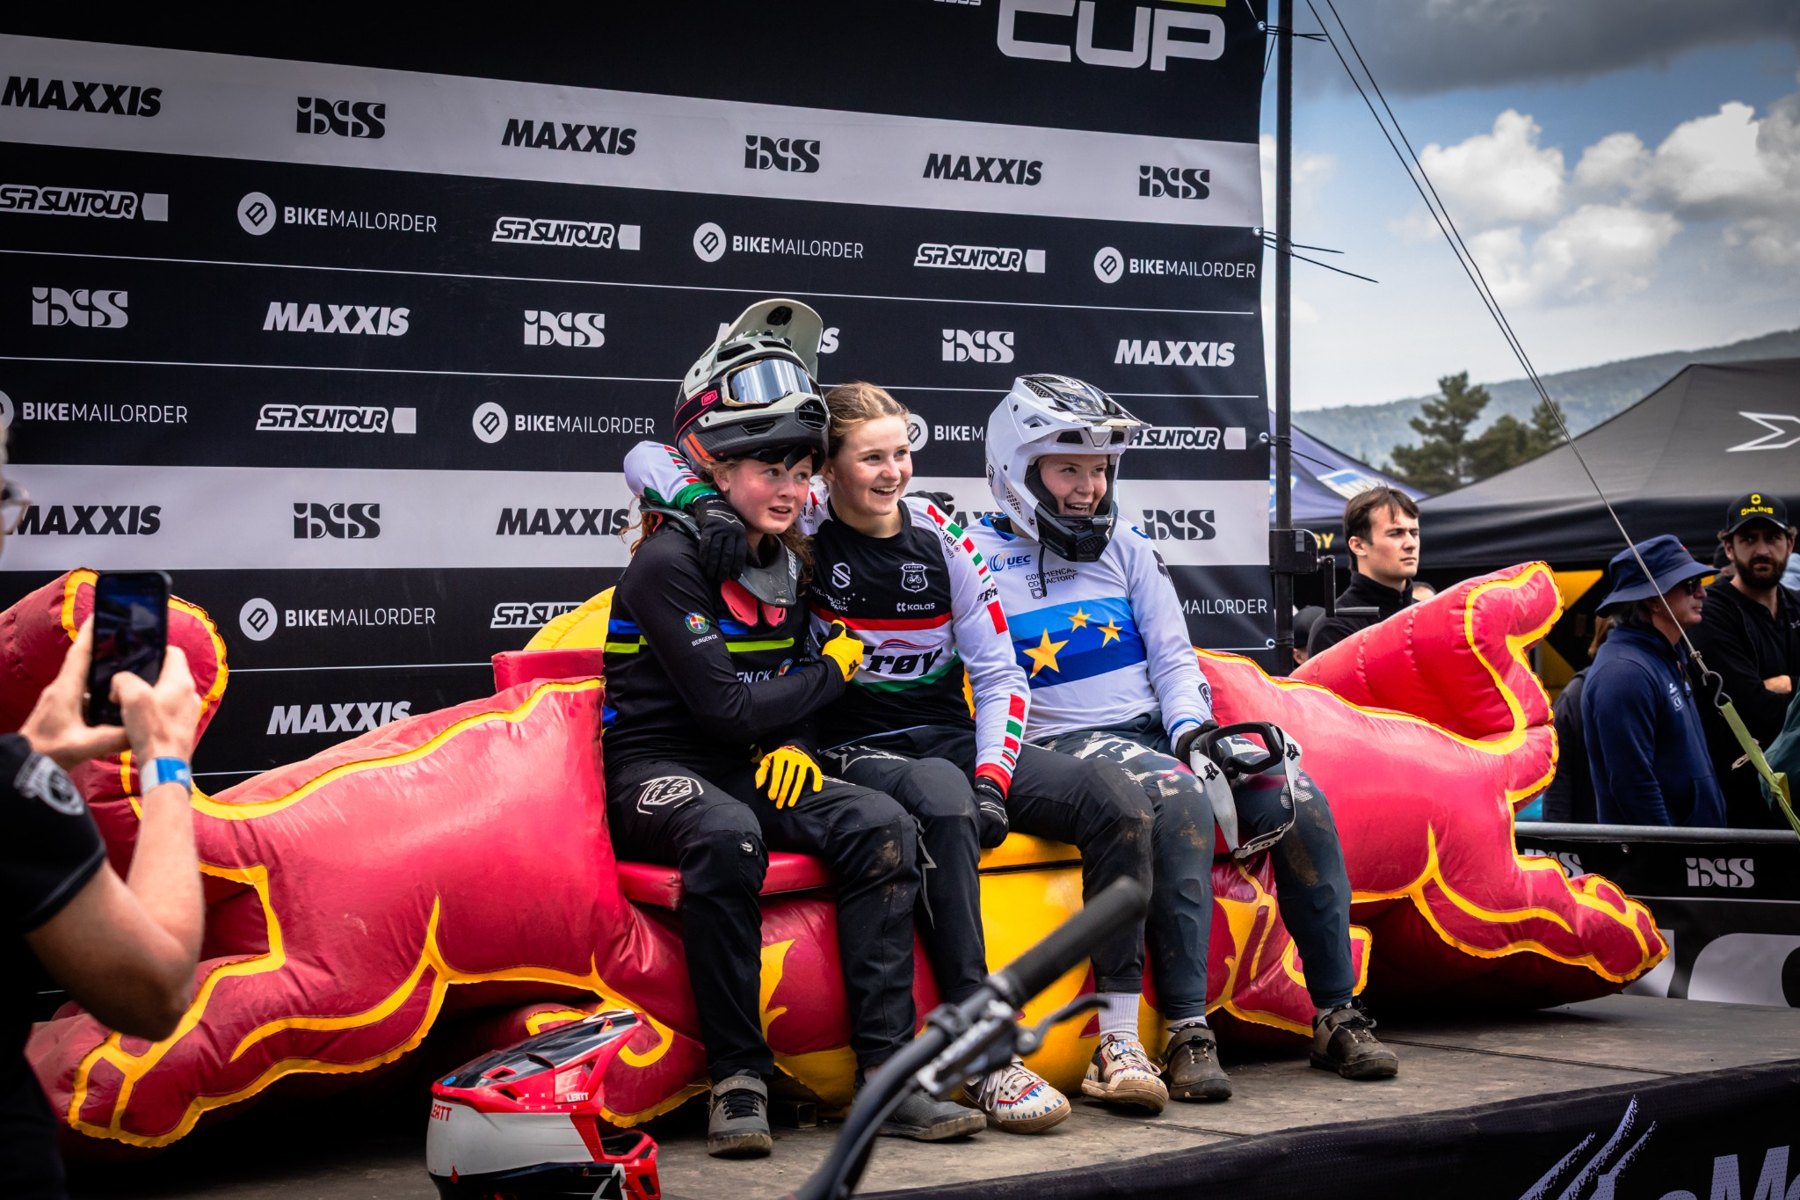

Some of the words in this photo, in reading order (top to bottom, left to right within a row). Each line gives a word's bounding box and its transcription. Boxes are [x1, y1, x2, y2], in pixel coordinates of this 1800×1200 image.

[997, 0, 1226, 71] CUP
[1, 76, 162, 117] MAXXIS
[501, 119, 637, 156] MAXXIS
[923, 153, 1043, 186] MAXXIS
[38, 186, 138, 219] SUNTOUR
[284, 205, 437, 233] BIKEMAILORDER
[530, 219, 615, 248] SUNTOUR
[732, 235, 864, 259] BIKEMAILORDER
[947, 245, 1022, 272] SUNTOUR
[1129, 258, 1256, 279] BIKEMAILORDER
[263, 302, 410, 336] MAXXIS
[1115, 340, 1235, 367] MAXXIS
[22, 402, 188, 424] BIKEMAILORDER
[298, 405, 388, 433] SUNTOUR
[515, 414, 655, 434] BIKEMAILORDER
[9, 505, 162, 536] MAXXIS
[496, 508, 630, 536] MAXXIS
[1007, 554, 1031, 566] UEC
[1027, 572, 1078, 588] CO-ACTORY
[285, 607, 436, 627] BIKEMAILORDER
[267, 701, 410, 735] MAXXIS
